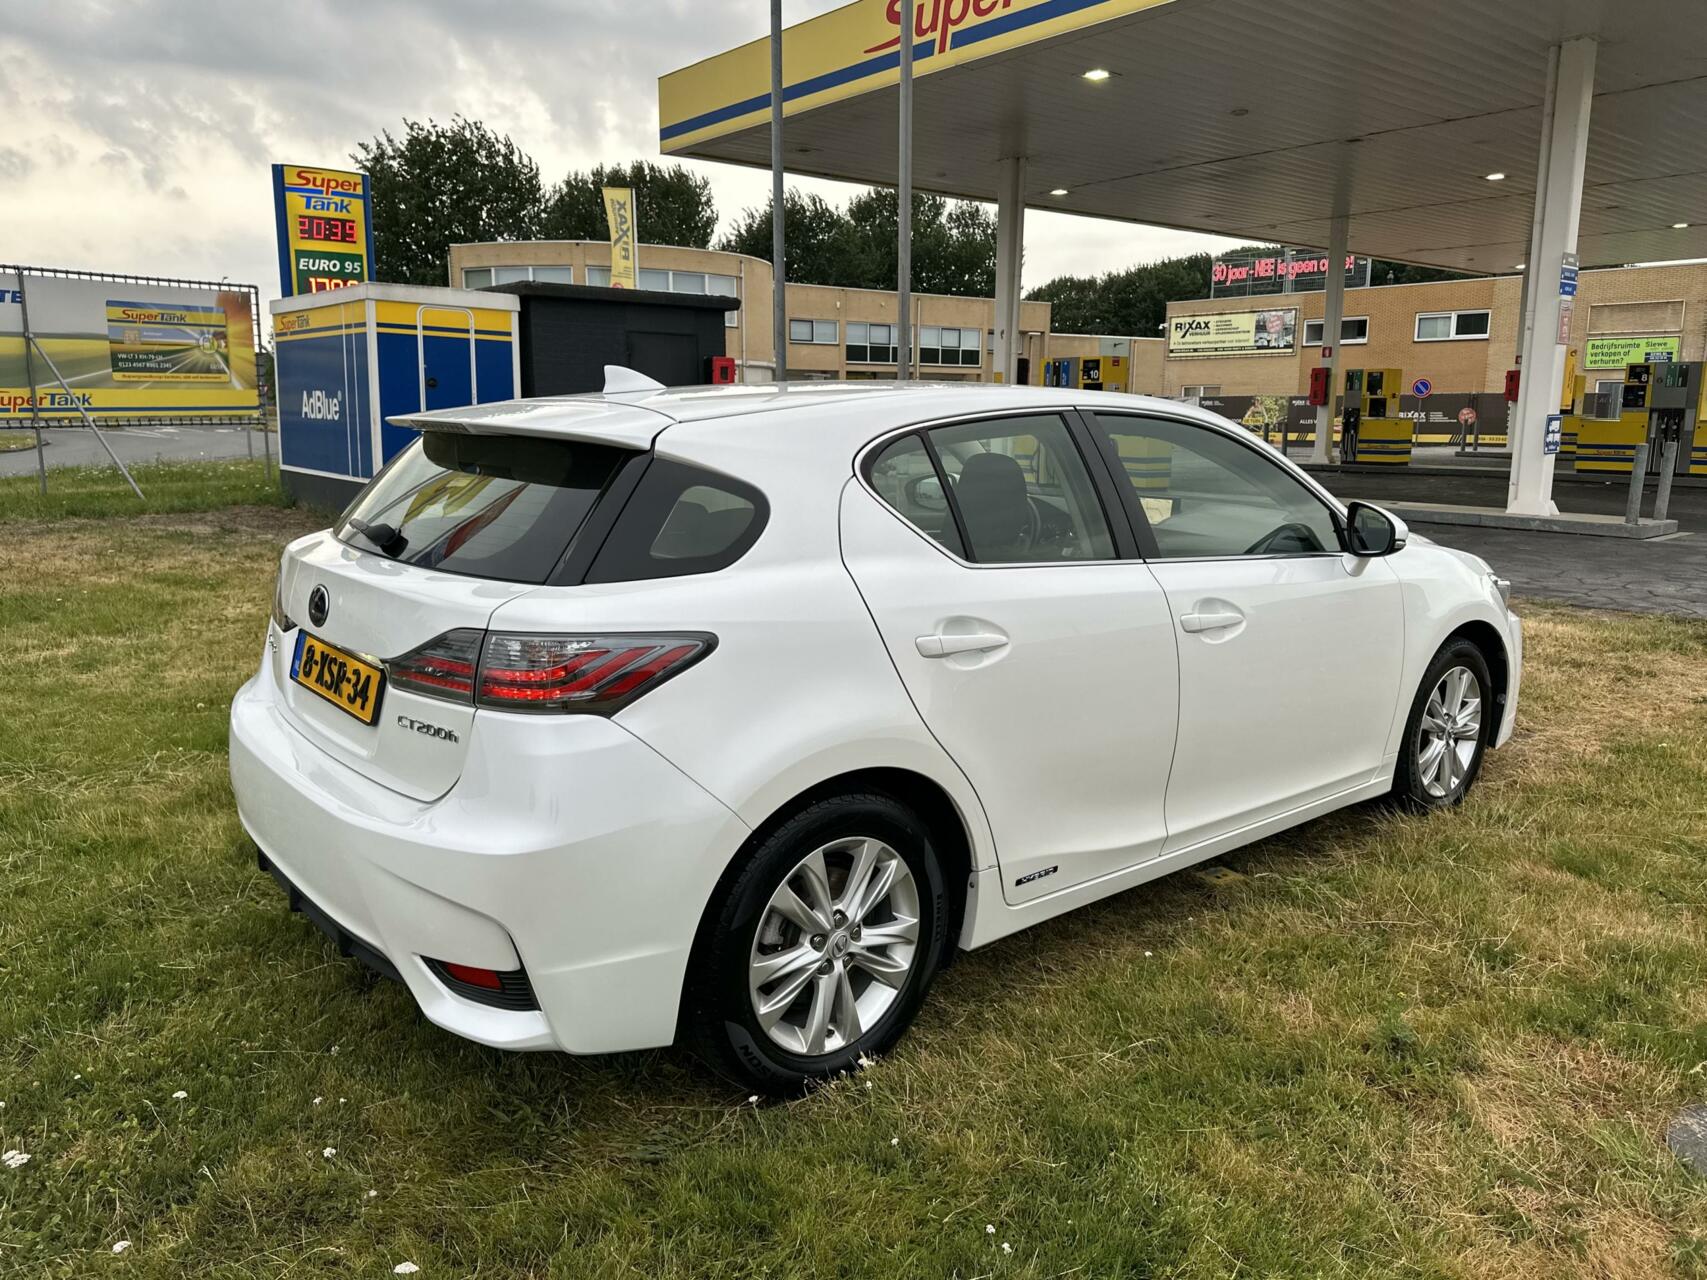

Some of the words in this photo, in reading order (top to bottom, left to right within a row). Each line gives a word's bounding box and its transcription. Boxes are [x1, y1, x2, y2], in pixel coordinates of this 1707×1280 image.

[286, 170, 361, 195] Super
[298, 195, 351, 213] Tank
[299, 258, 340, 271] EURO
[344, 262, 361, 273] 95
[1254, 258, 1275, 277] NEE
[1277, 257, 1287, 275] is
[1288, 259, 1317, 280] geen
[122, 309, 187, 324] SuperTank
[279, 315, 310, 332] SuperTank
[1175, 320, 1211, 338] RIXAX
[1591, 341, 1641, 350] Bedrijfsruimte
[1090, 369, 1099, 379] 10
[1641, 374, 1648, 382] 8
[302, 644, 371, 712] 8-XSR-34
[397, 715, 460, 744] CT200h
